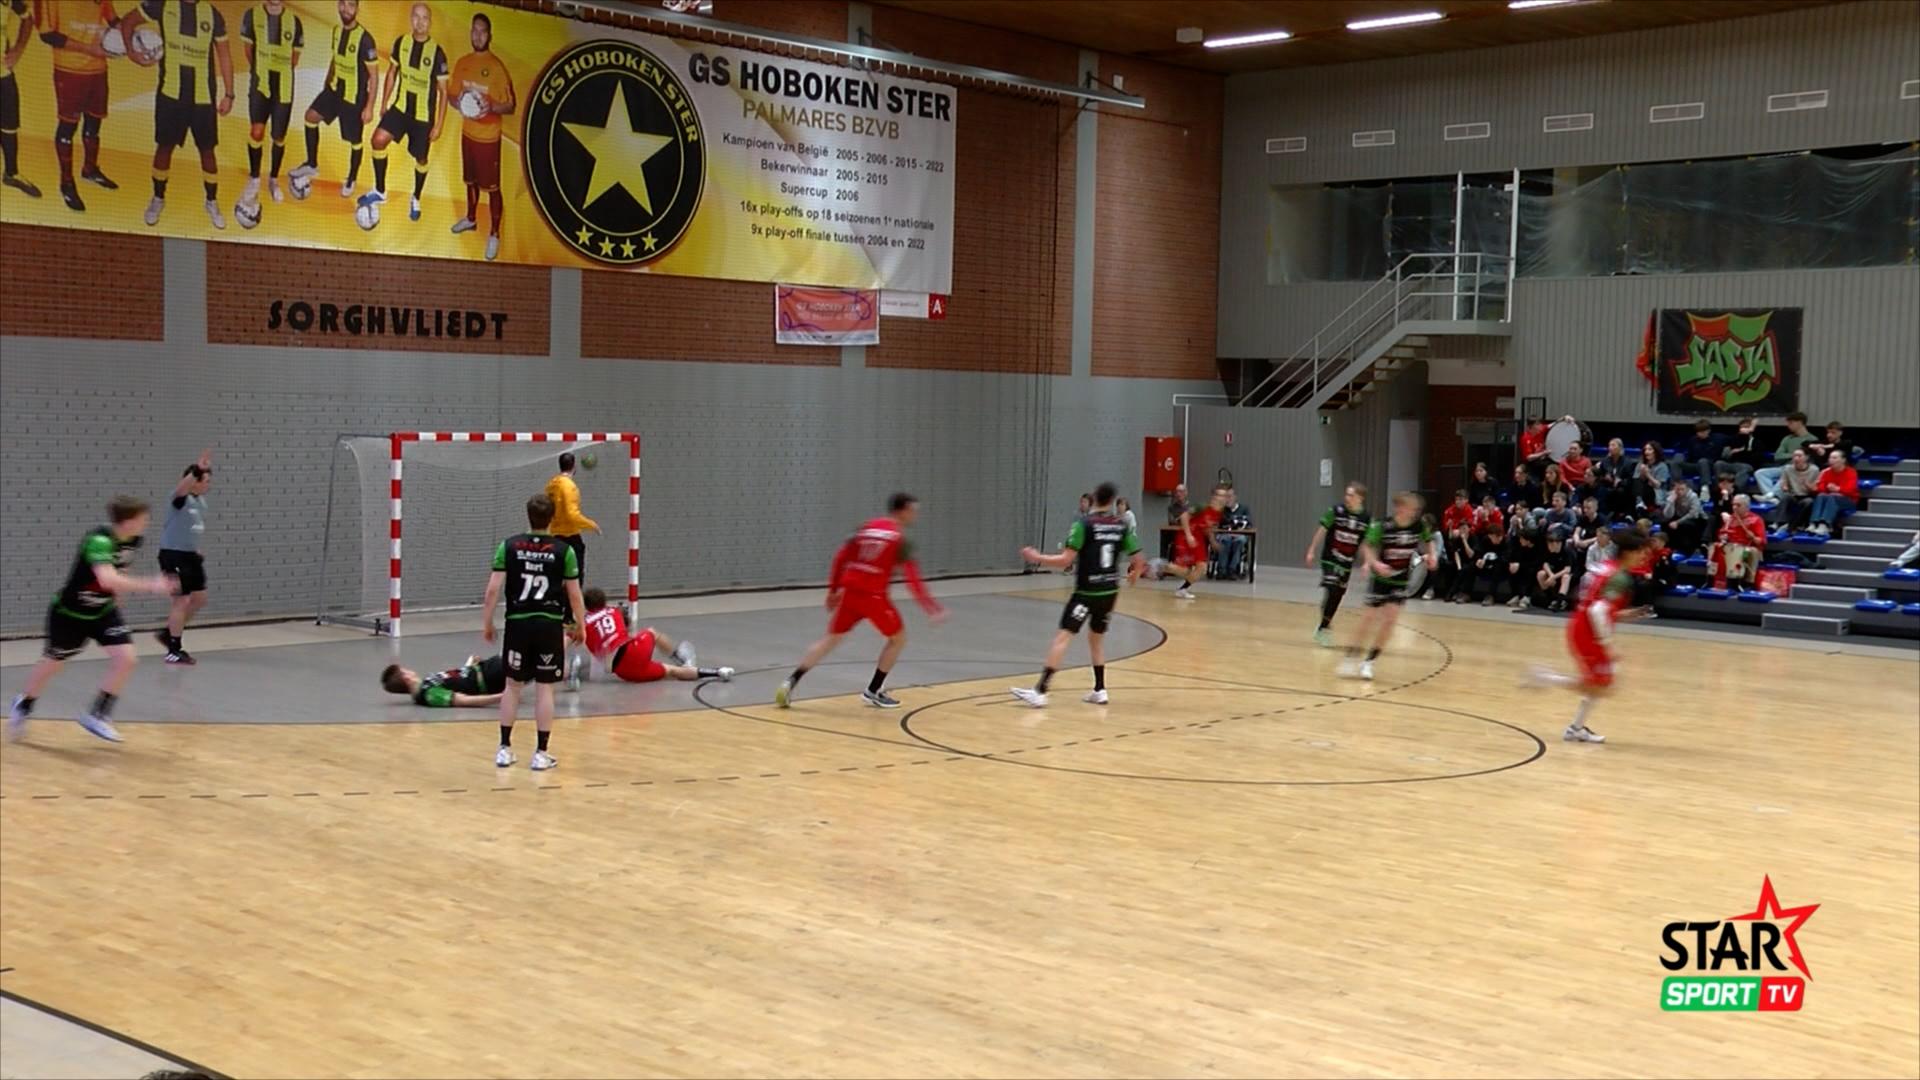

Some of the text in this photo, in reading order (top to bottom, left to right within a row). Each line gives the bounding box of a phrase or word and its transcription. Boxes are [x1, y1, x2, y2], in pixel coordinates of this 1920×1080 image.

[541, 50, 699, 143] GS HOBOKEN STER
[689, 53, 951, 122] GS HOBOKEN STER
[743, 100, 899, 140] PALMARES BZVB
[722, 132, 775, 150] Kampioen
[777, 141, 795, 153] van
[798, 141, 829, 159] België
[836, 149, 859, 162] 2005
[866, 152, 888, 165] 2006
[895, 155, 917, 169] 2015
[926, 159, 944, 173] 2022
[761, 158, 828, 177] Bekerwinnaar
[836, 169, 860, 182] 2005
[866, 172, 888, 186] 2015
[780, 182, 859, 202] Supercup 2006
[740, 200, 758, 213] 16x
[760, 201, 804, 218] play-offs
[807, 211, 819, 220] op
[821, 209, 832, 221] 18
[834, 212, 881, 225] seizoenen
[894, 218, 935, 231] nationale
[751, 223, 925, 250] 9x play-off finale tussen 2004 en 2022
[267, 300, 508, 340] SORGHVLIEDT
[932, 299, 943, 315] A
[519, 573, 549, 600] 72
[594, 616, 616, 638] 19
